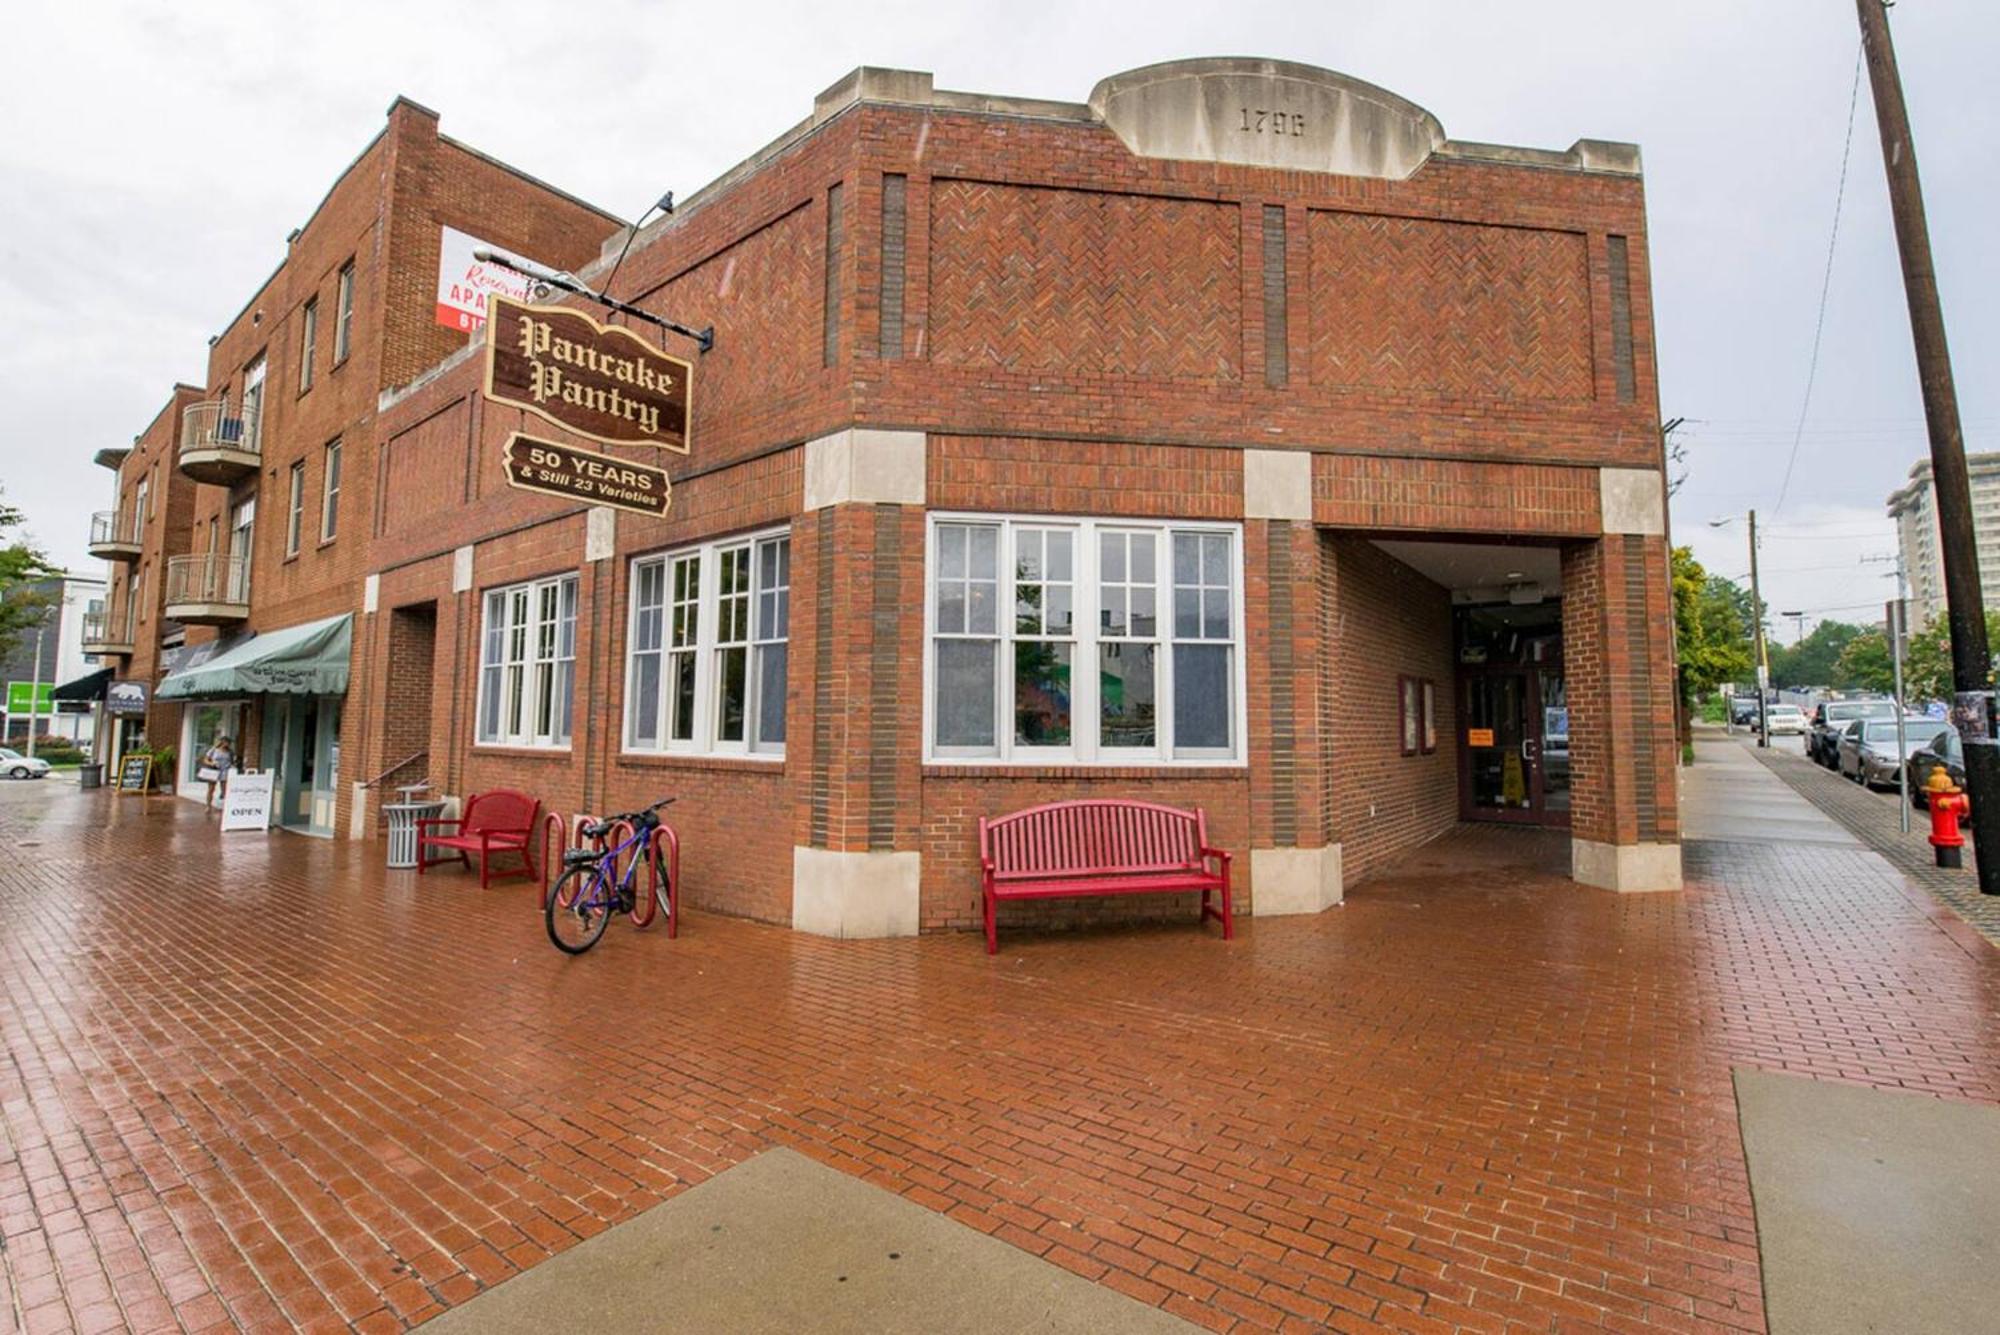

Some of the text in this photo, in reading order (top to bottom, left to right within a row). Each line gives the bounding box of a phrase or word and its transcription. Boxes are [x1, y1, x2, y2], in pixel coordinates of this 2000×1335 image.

[450, 284, 486, 310] APA
[518, 316, 673, 395] Pancake
[529, 360, 659, 433] Pantry
[520, 465, 658, 505] & Still 23 Varieties
[530, 448, 652, 490] 50 YEARS
